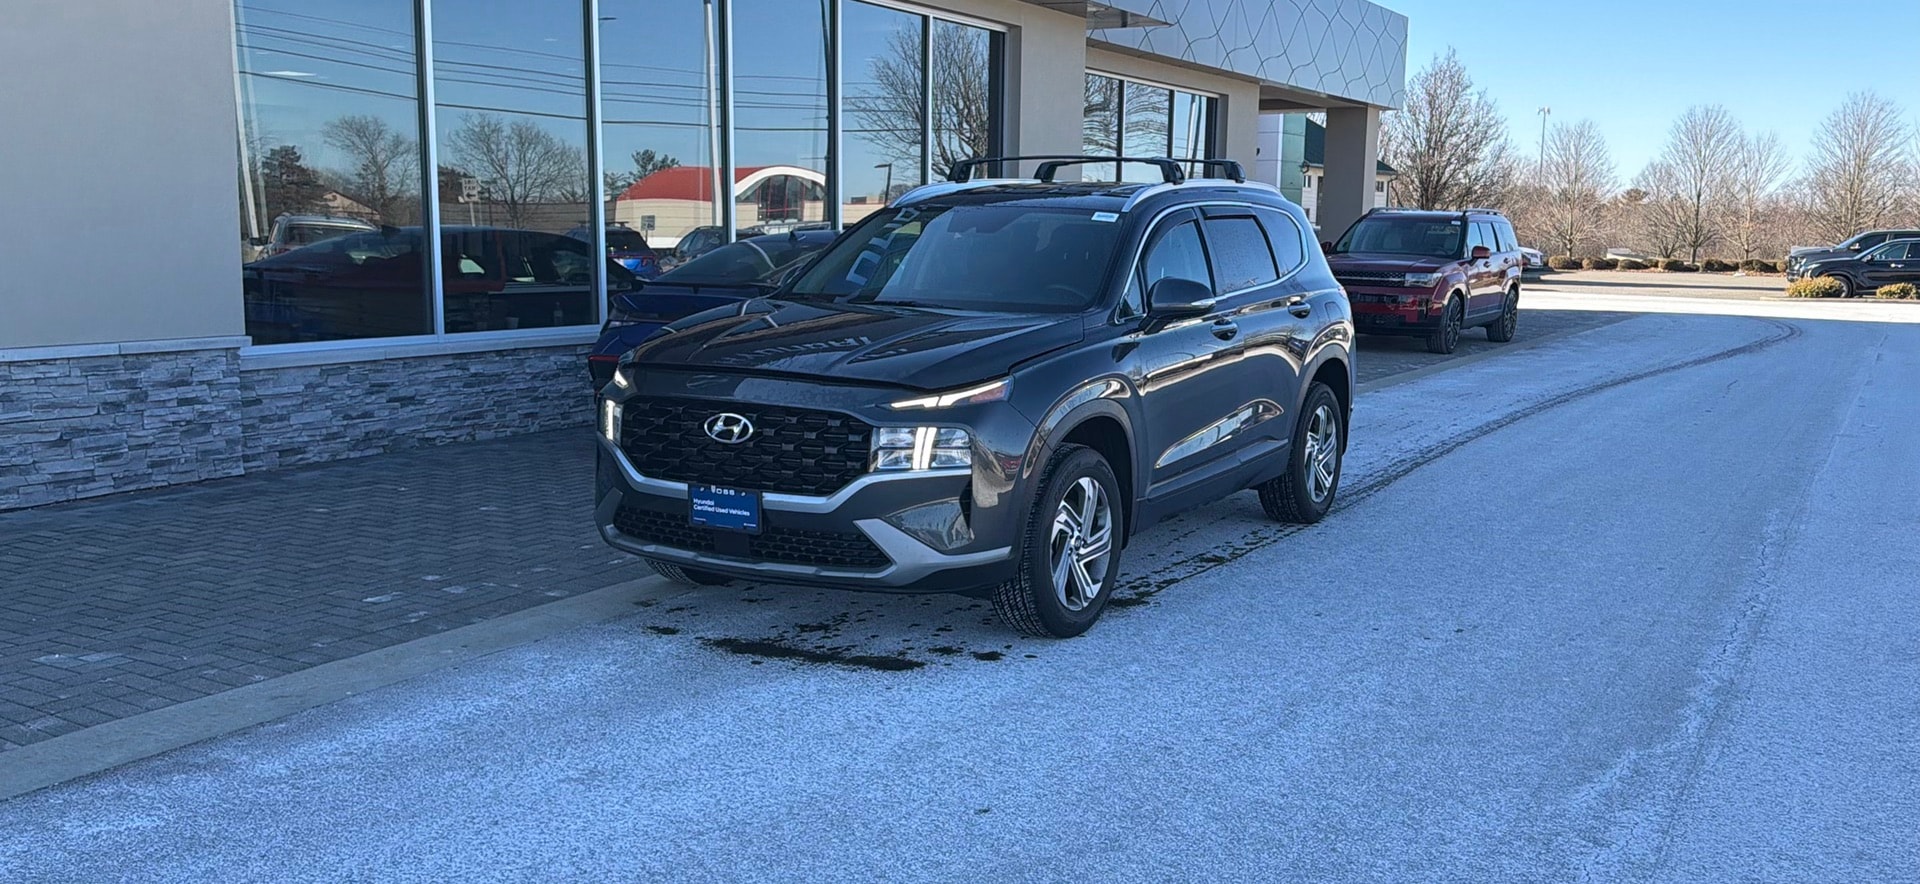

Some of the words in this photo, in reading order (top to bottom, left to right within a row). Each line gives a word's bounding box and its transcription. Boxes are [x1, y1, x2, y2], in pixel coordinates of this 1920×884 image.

[693, 498, 715, 506] Hyundai
[693, 504, 715, 512] Certified
[729, 508, 750, 516] Vehicles
